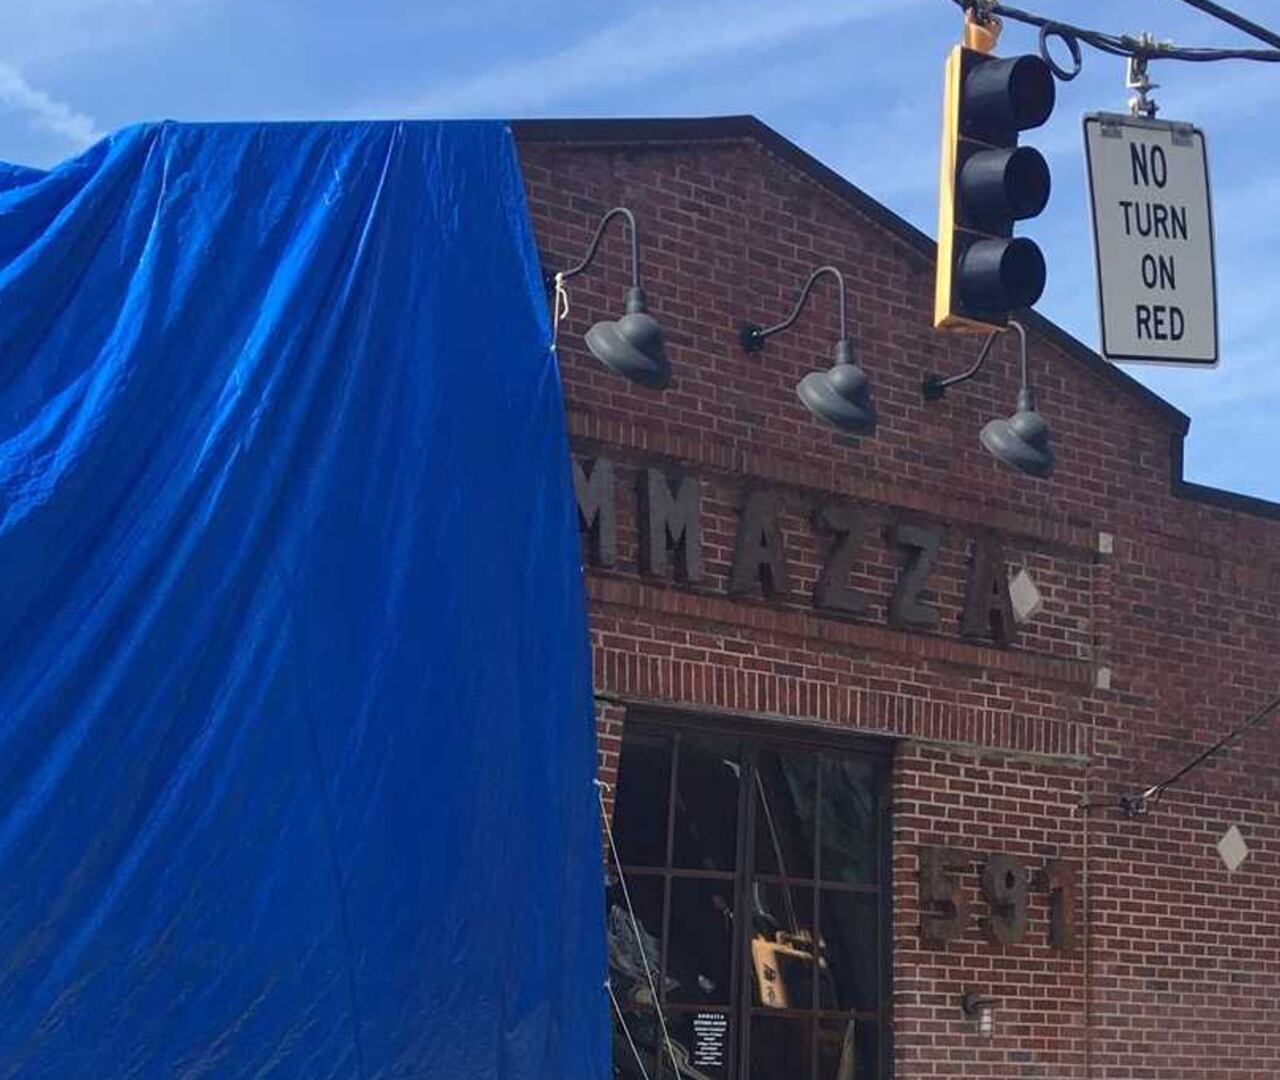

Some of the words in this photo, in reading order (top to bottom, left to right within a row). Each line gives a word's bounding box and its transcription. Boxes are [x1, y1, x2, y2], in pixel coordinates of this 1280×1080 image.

[1129, 141, 1168, 189] NO
[1119, 200, 1188, 240] TURN
[1141, 253, 1177, 291] ON
[1135, 304, 1185, 342] RED
[920, 847, 1076, 948] 591
